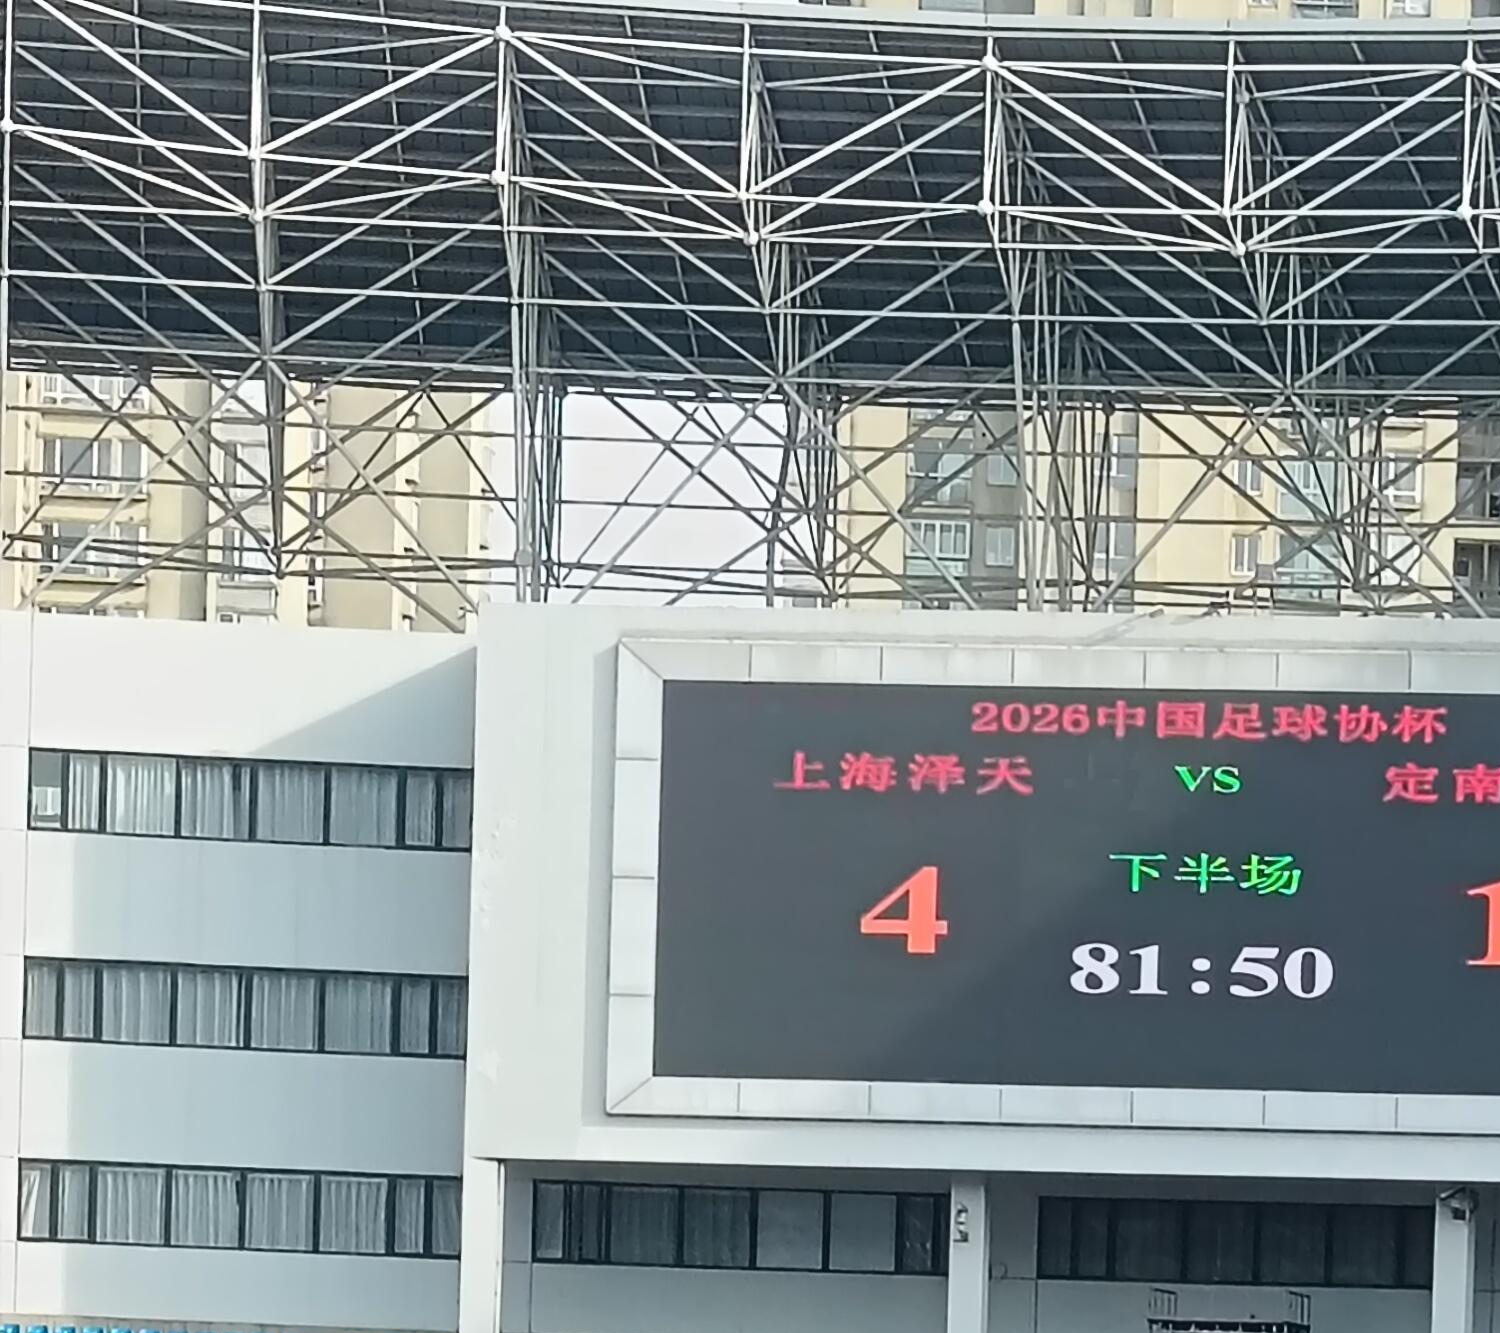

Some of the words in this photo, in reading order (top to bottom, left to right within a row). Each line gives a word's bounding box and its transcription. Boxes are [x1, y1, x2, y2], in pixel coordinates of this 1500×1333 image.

[970, 699, 1449, 744] 2026中国足球协杯
[773, 751, 1034, 795] 上海泽天
[1174, 765, 1241, 794] VS
[1109, 852, 1303, 895] 下半场
[860, 866, 948, 954] 4
[1069, 942, 1335, 999] 81:50
